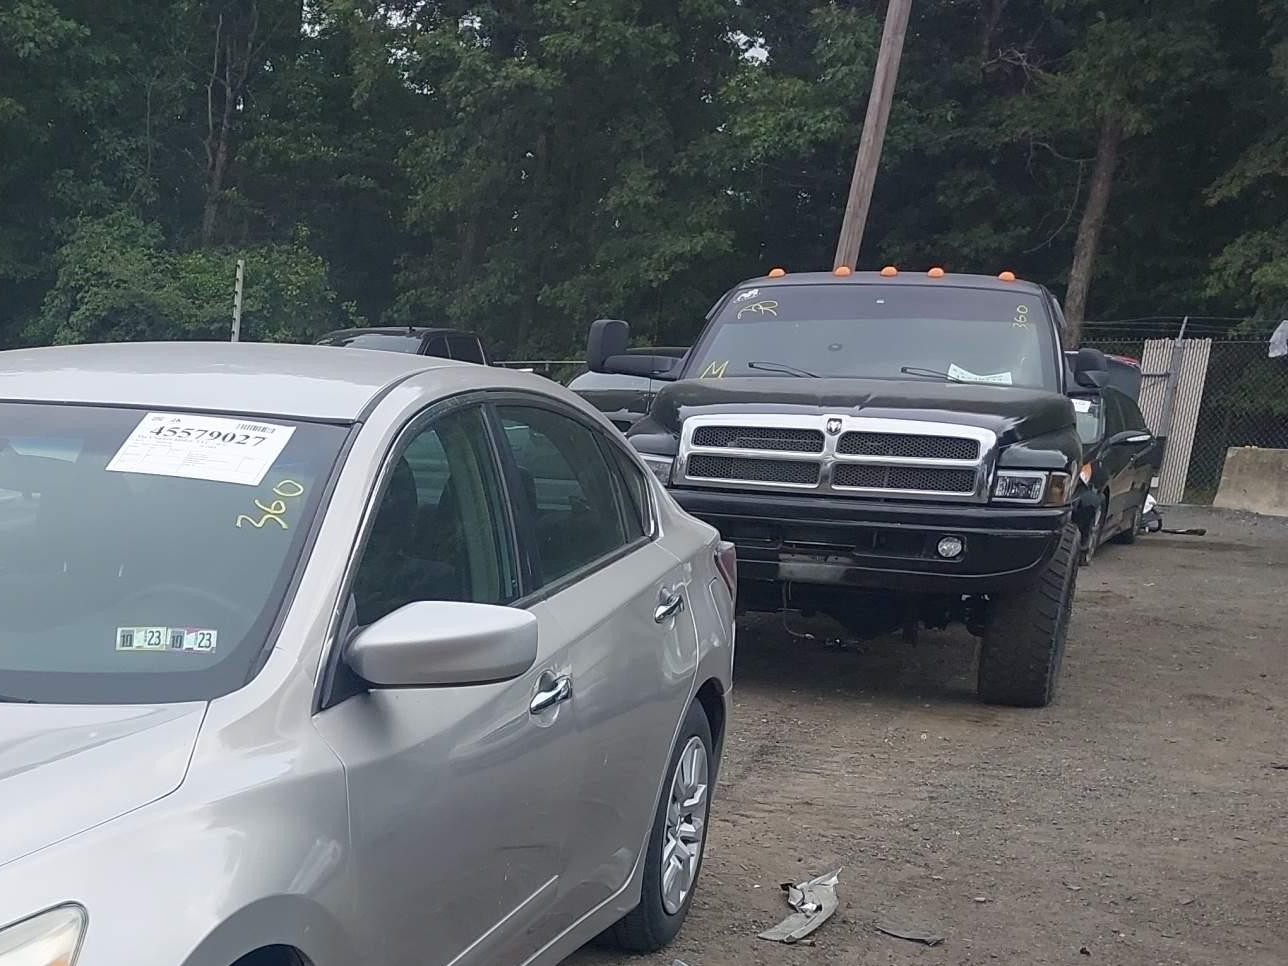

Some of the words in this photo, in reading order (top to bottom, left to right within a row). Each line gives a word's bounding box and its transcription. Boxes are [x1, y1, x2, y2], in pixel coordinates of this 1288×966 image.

[149, 425, 268, 447] 45579027
[235, 479, 305, 529] 360
[147, 630, 162, 647] 23
[197, 632, 212, 649] 23
